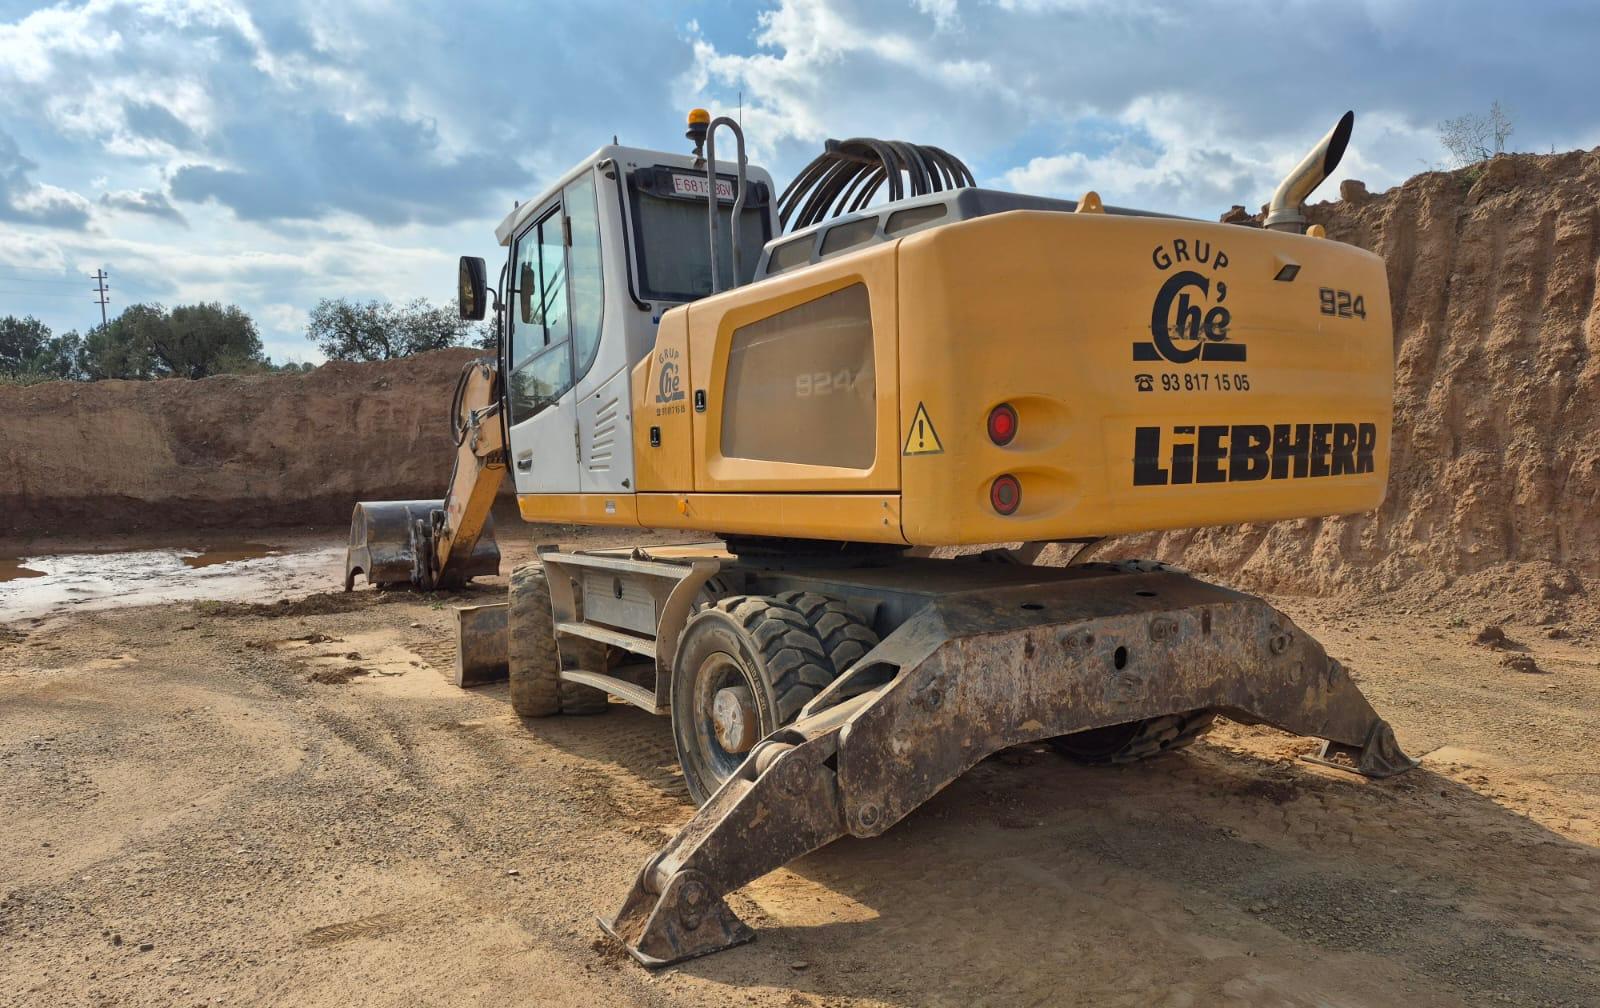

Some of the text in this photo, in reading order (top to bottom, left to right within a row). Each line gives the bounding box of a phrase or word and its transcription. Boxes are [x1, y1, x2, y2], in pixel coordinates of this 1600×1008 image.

[1152, 238, 1229, 271] GRUP
[1319, 287, 1366, 320] 924
[658, 348, 680, 364] GRUP
[1161, 373, 1250, 391] 93 817 15 05
